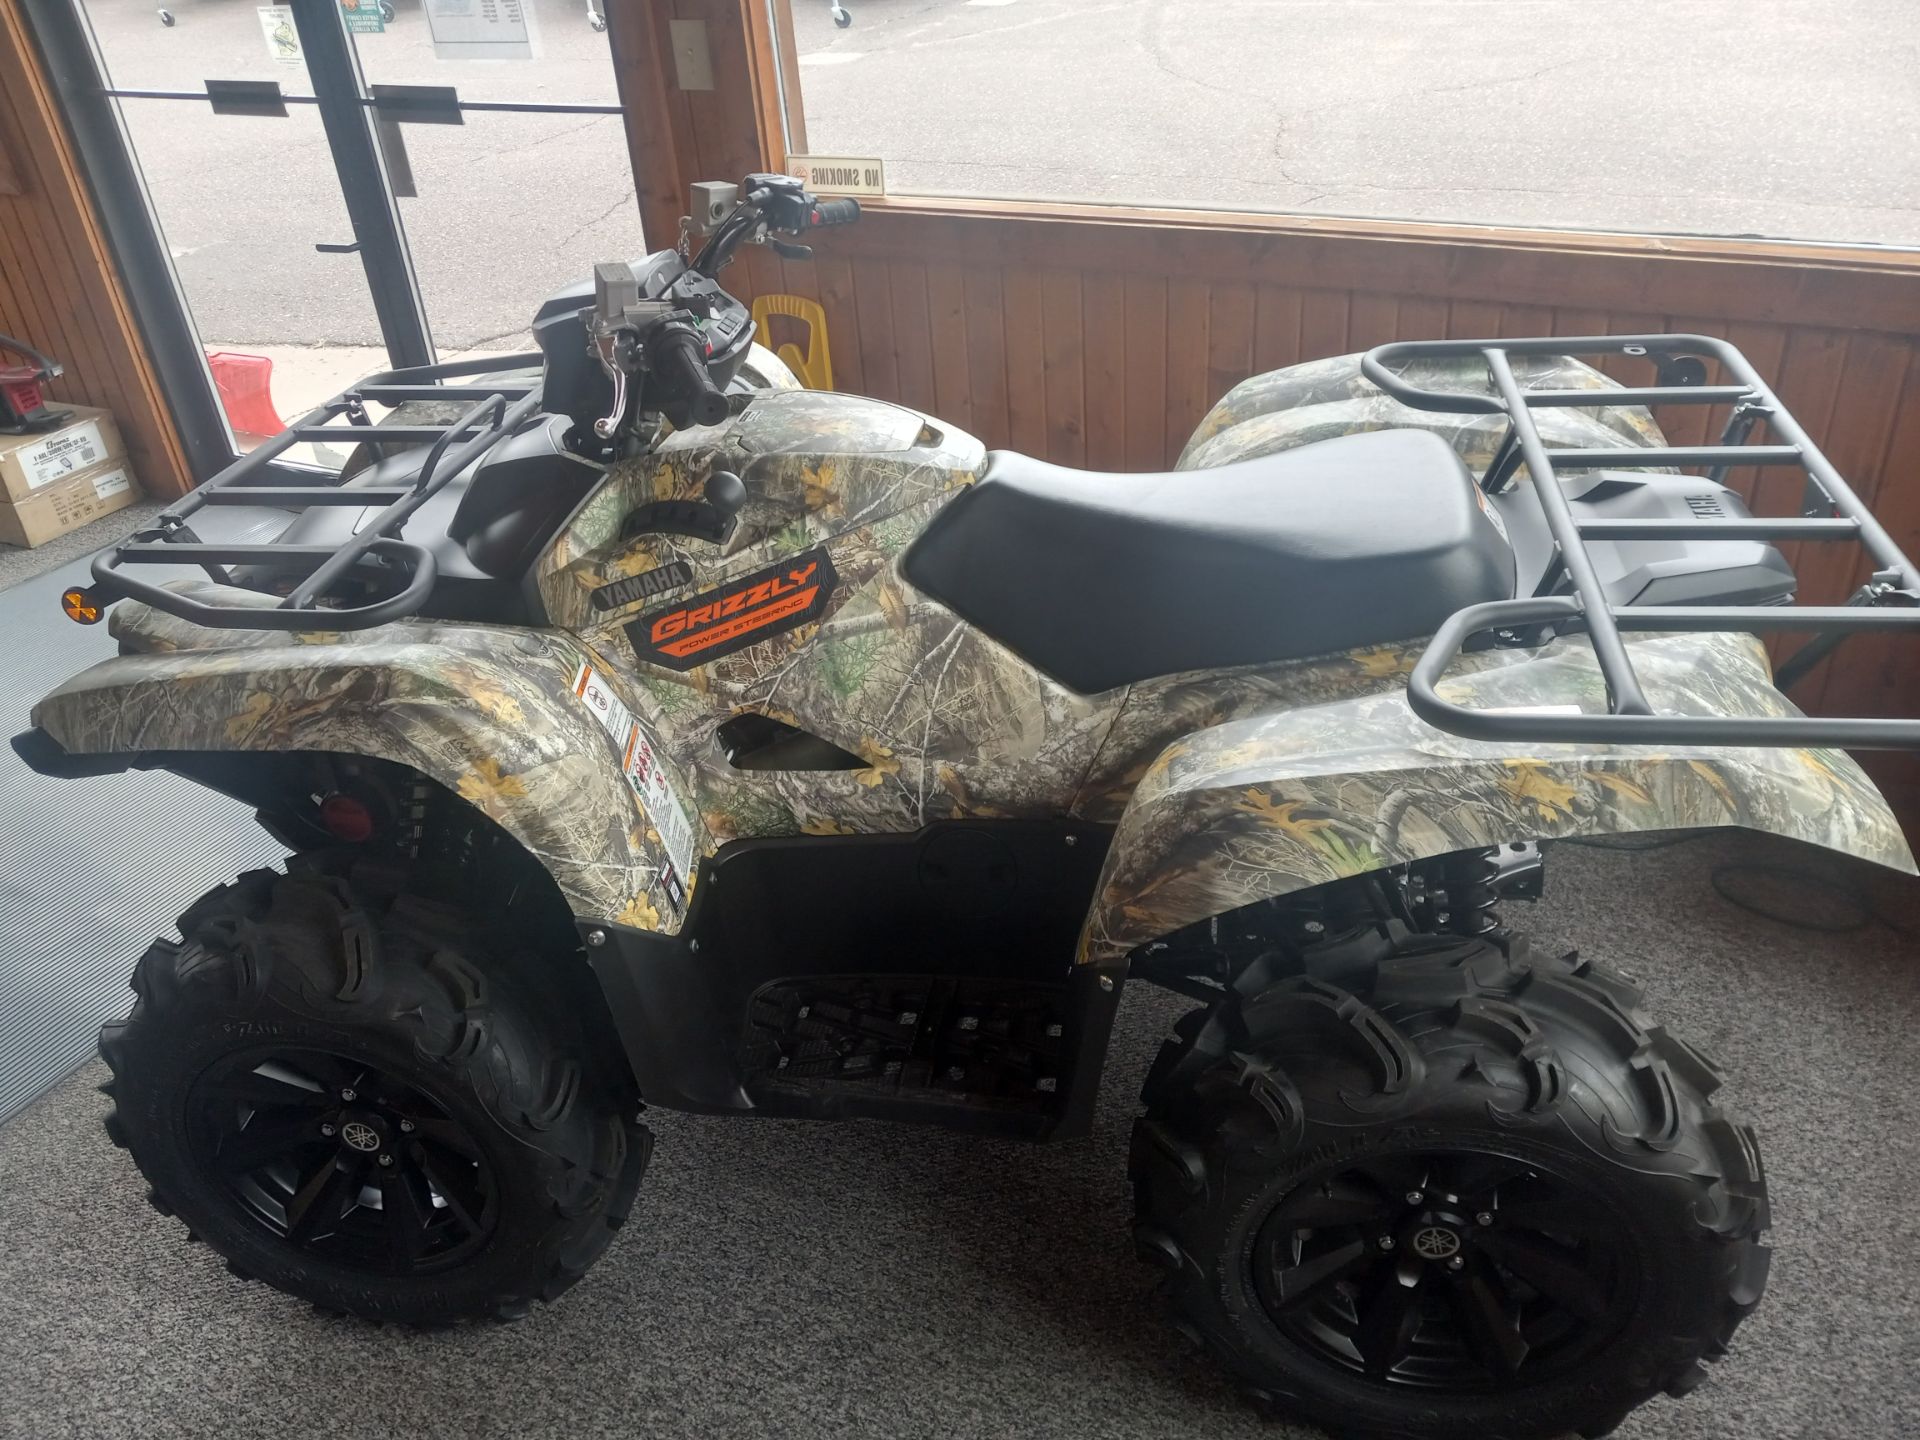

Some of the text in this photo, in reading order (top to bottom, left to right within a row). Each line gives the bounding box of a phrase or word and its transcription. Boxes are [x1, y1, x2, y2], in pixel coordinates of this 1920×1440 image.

[599, 565, 686, 608] YAMAHA
[651, 562, 818, 644] GRIZZLY
[679, 598, 804, 652] POWER STEERING
